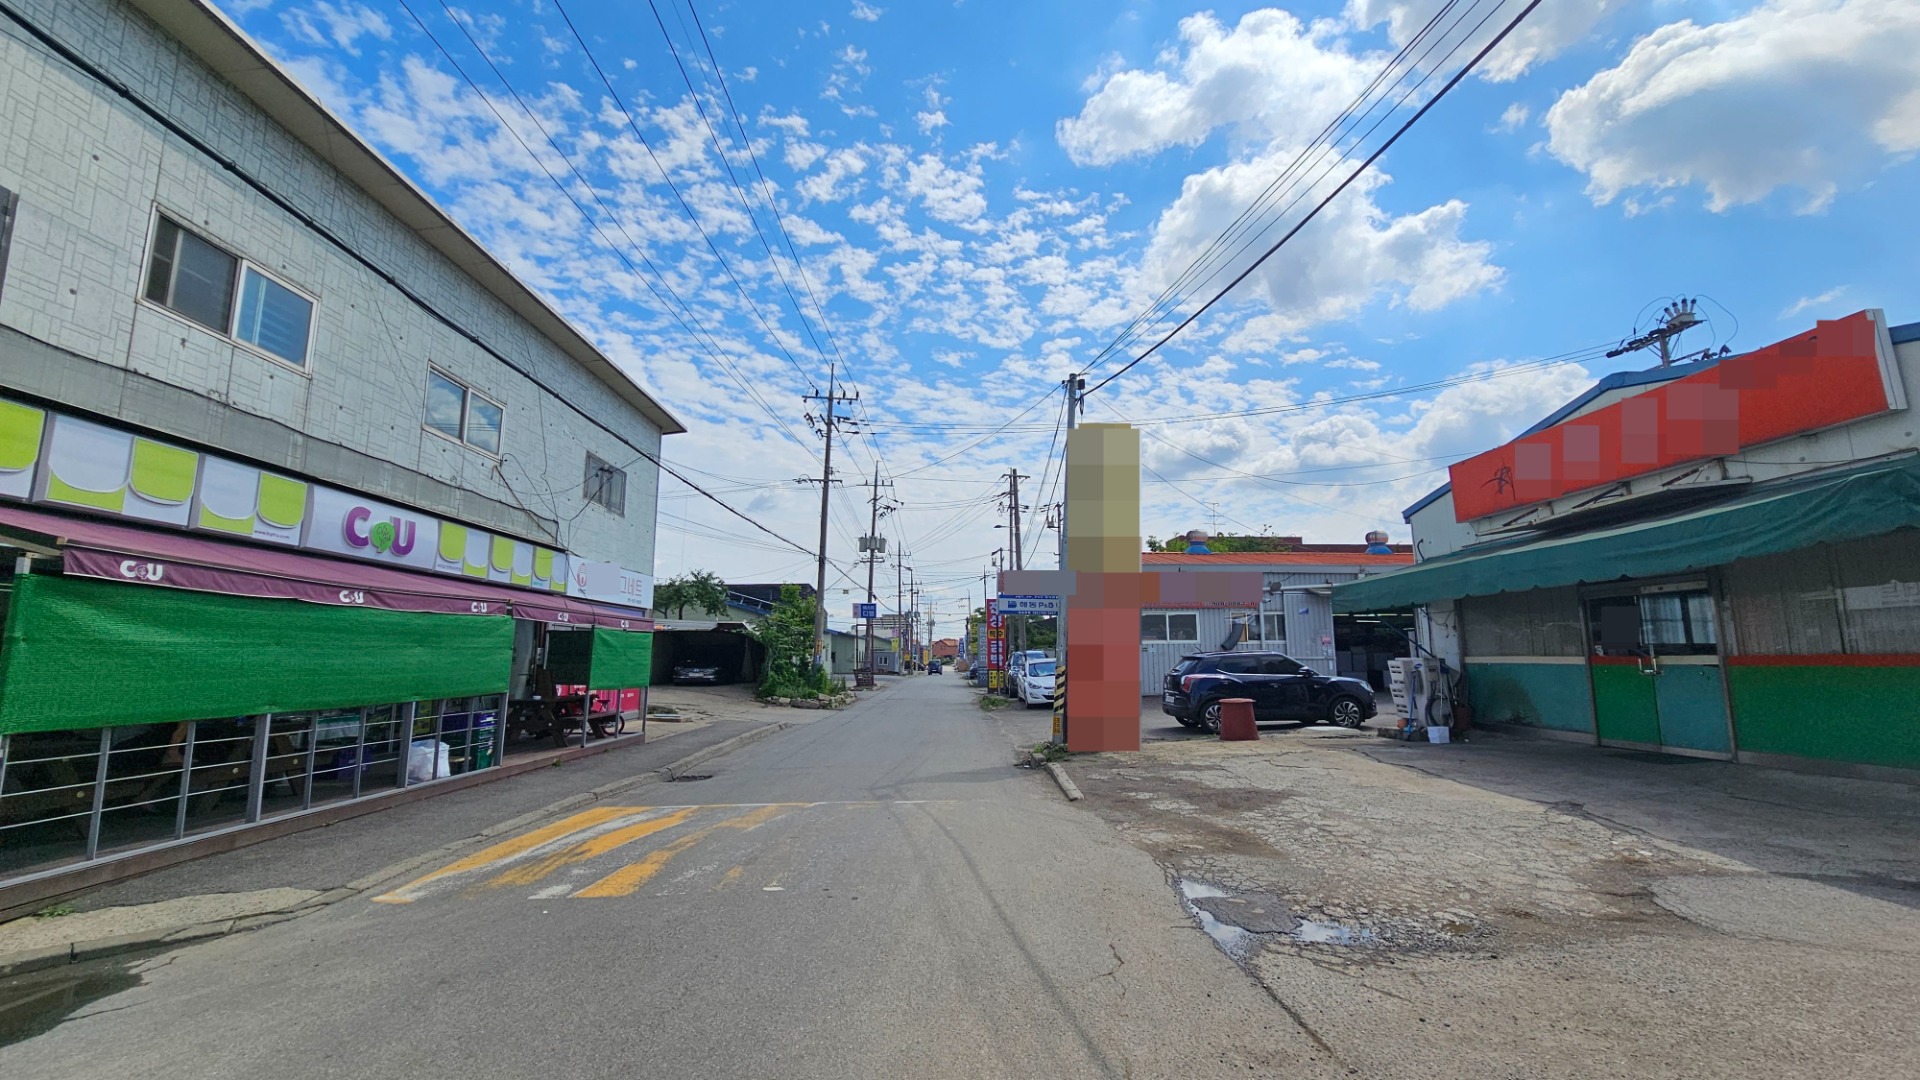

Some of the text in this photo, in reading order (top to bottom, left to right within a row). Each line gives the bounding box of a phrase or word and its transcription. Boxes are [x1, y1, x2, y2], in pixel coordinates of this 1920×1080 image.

[344, 506, 417, 557] CU
[120, 559, 163, 581] CU
[339, 590, 364, 604] CU
[471, 602, 487, 613] CU
